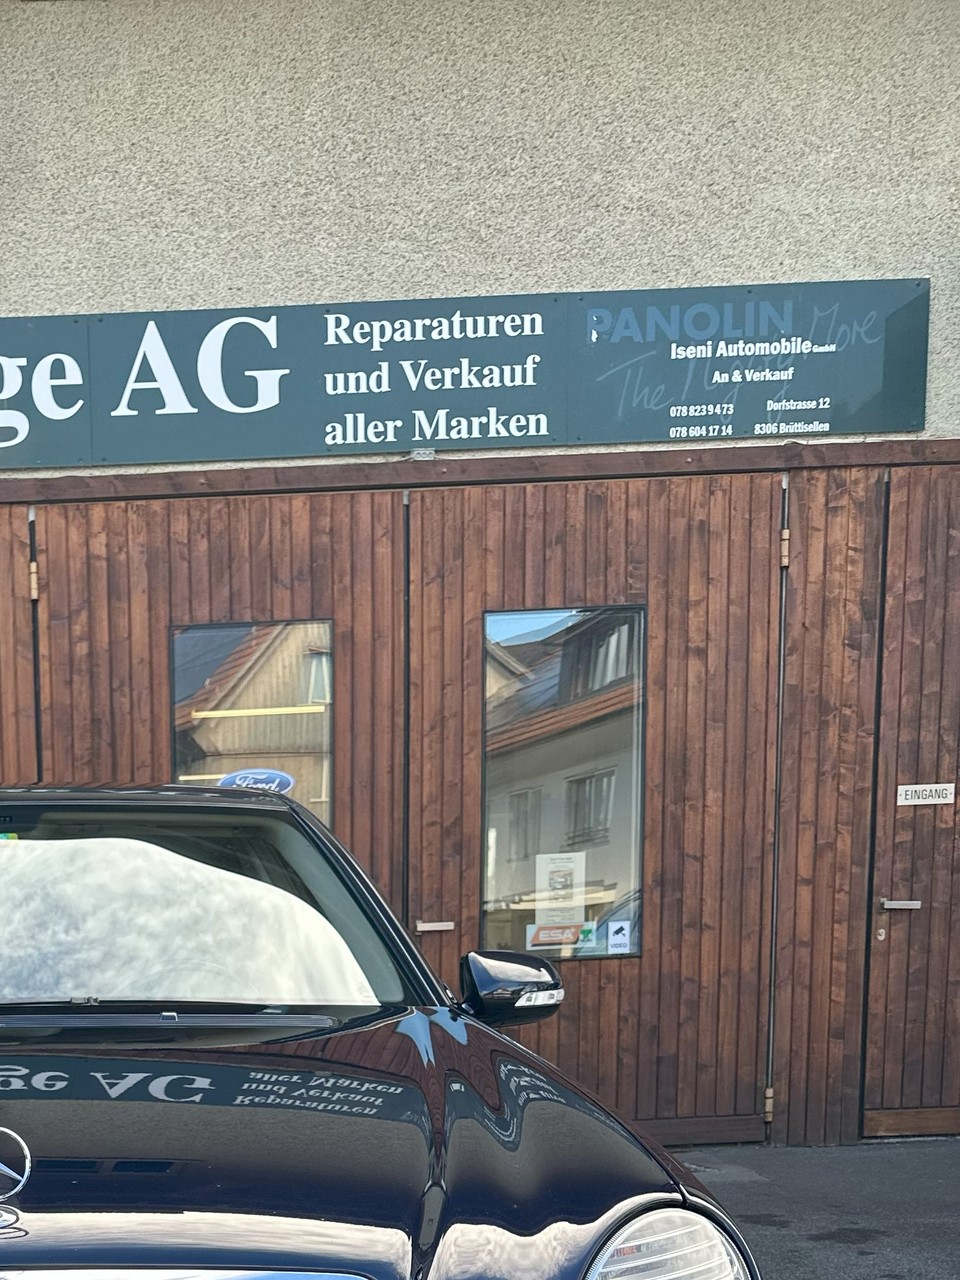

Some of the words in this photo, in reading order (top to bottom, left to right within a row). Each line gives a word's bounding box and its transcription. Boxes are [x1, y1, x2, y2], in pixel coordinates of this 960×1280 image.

[323, 310, 544, 352] Reparaturen
[586, 300, 793, 345] PANOLIN
[670, 340, 713, 360] Iseni
[715, 336, 813, 358] Automobile
[110, 315, 291, 418] AG
[323, 361, 392, 396] und
[398, 354, 542, 392] Verkauf
[711, 370, 730, 384] An
[731, 369, 743, 383] &
[744, 366, 795, 382] Verkauf
[669, 405, 688, 418] 078
[688, 404, 707, 417] 823
[766, 399, 817, 412] Dorfstrasse
[818, 397, 831, 410] 12
[324, 412, 403, 446] aller
[411, 406, 550, 442] Marken
[669, 426, 688, 438] 078
[688, 425, 707, 437] 604
[707, 425, 720, 437] 17
[720, 424, 734, 436] 14
[753, 422, 779, 435] 8306
[779, 420, 830, 434] Brüttisellen
[904, 788, 948, 801] EINGANG
[539, 928, 575, 941] ESA
